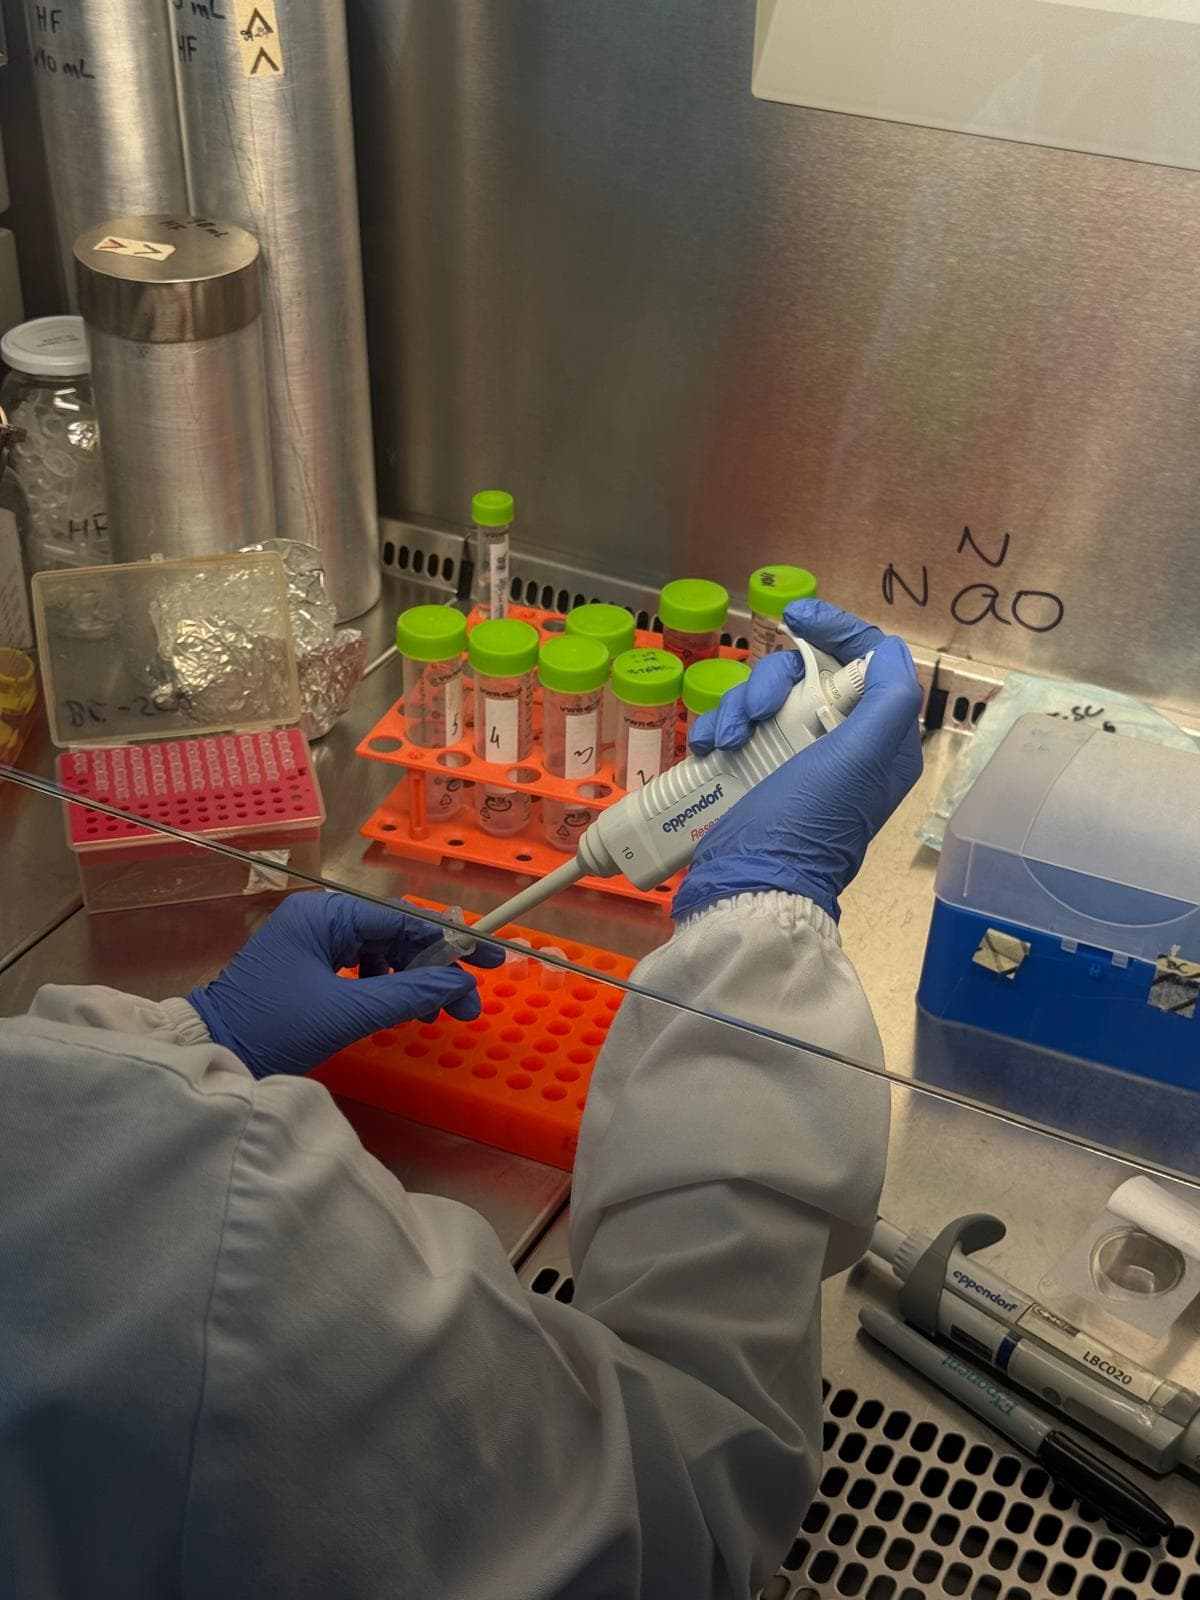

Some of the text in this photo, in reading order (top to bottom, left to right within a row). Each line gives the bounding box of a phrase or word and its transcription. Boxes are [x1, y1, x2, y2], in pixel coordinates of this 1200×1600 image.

[35, 5, 63, 34] HF
[177, 31, 198, 62] HF
[68, 512, 109, 541] HF
[489, 725, 501, 750] 4
[573, 746, 594, 765] 3
[662, 783, 724, 833] eppendorf
[621, 845, 634, 861] 10
[953, 1269, 1018, 1313] eppendorf
[1082, 1350, 1133, 1386] LBC020
